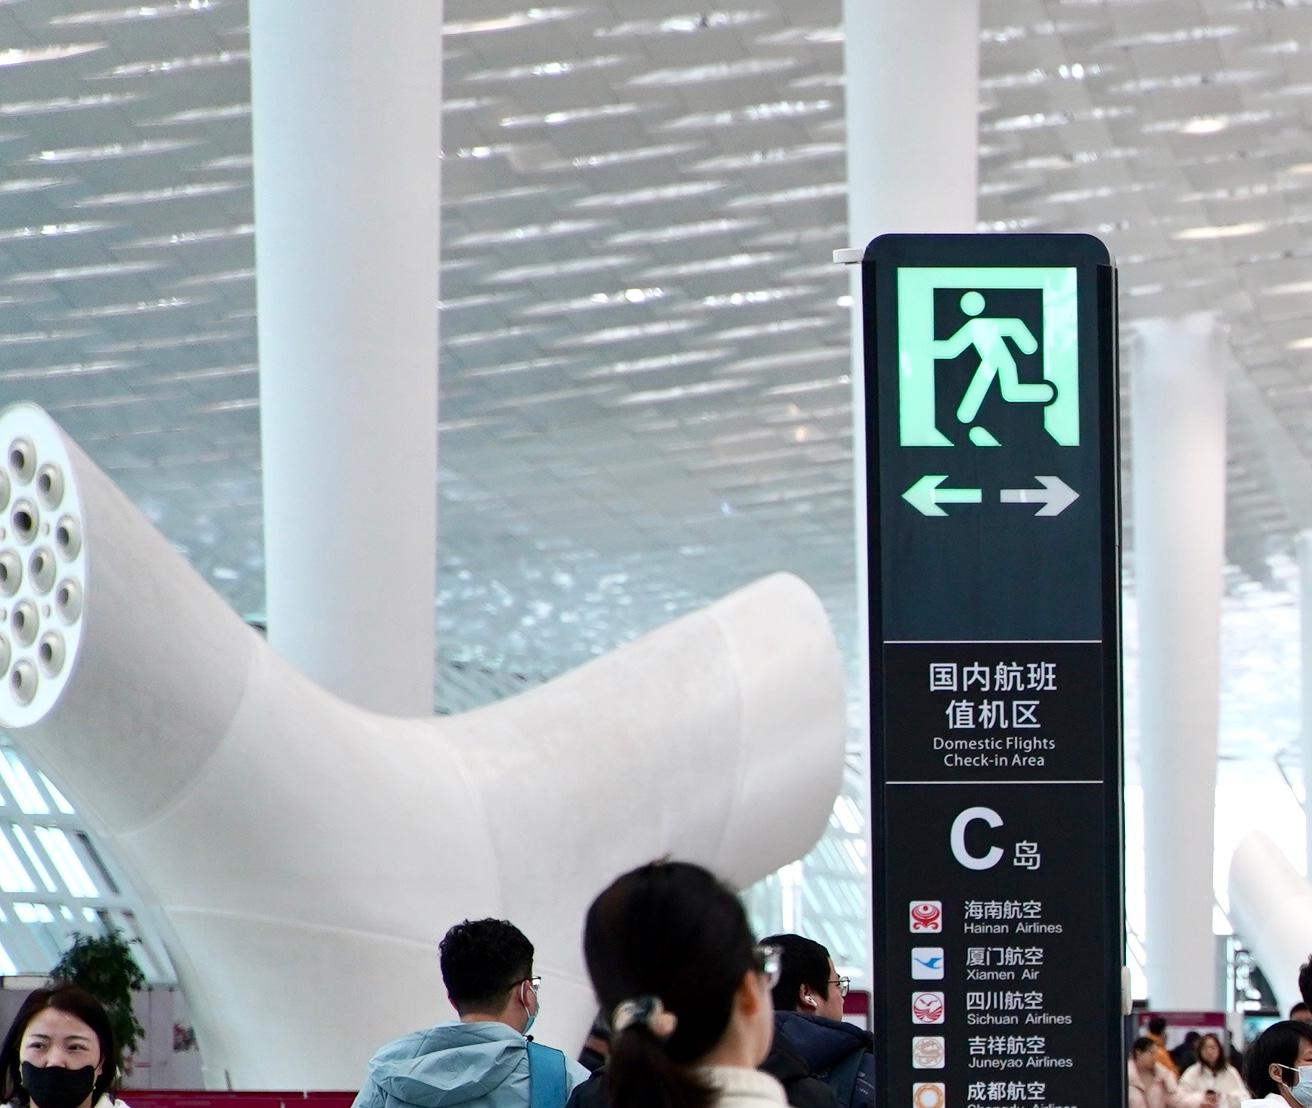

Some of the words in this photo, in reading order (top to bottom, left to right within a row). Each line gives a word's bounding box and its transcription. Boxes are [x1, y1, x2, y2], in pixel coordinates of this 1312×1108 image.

[930, 662, 1057, 691] 国内航班
[946, 700, 1040, 729] 值机区
[934, 737, 1002, 749] Domestic
[1007, 737, 1055, 752] Flights
[944, 754, 1007, 766] Check-in
[1012, 754, 1044, 766] Area
[951, 807, 1003, 870] C
[1014, 841, 1040, 869] 岛
[965, 900, 1041, 919] 海南航空
[965, 923, 1008, 933] Hainan
[1016, 922, 1062, 933] Airlines
[967, 947, 1043, 966] 厦门航空
[967, 969, 1014, 980] Xiamen
[1022, 969, 1039, 979] Air
[967, 991, 1042, 1010] 四川航空
[968, 1014, 1018, 1024] Sichuan
[1025, 1013, 1072, 1024] Airlines
[968, 1036, 1045, 1054] 吉祥航空
[969, 1057, 1023, 1070] Juneyao
[1026, 1057, 1073, 1067] Airlines
[968, 1081, 1045, 1100] 成都航空
